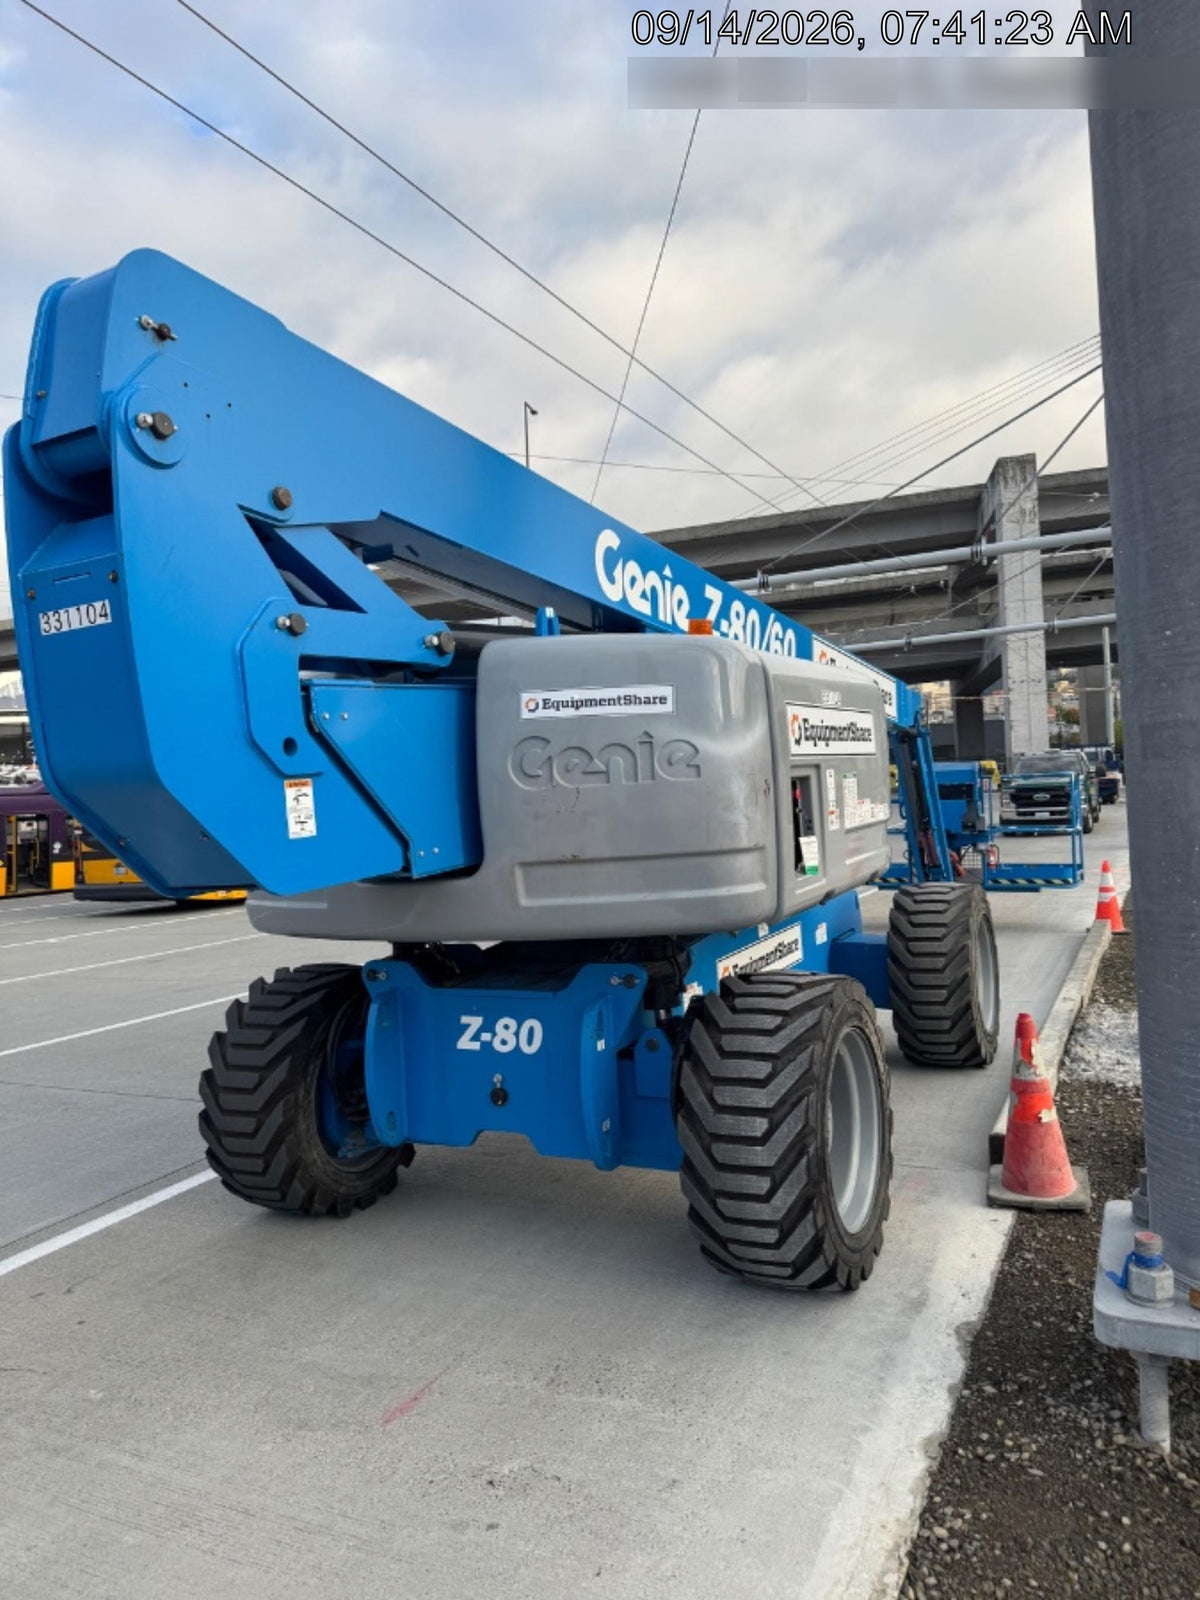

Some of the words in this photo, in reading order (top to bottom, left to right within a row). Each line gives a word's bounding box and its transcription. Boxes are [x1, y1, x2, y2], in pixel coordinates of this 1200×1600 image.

[595, 529, 691, 632] Genie
[704, 583, 796, 658] Z-80/60
[41, 601, 109, 633] 331104
[541, 694, 668, 712] EquipmentShare
[801, 717, 873, 748] EquipmentShare
[508, 730, 701, 791] Genie
[456, 1015, 543, 1055] Z-80
